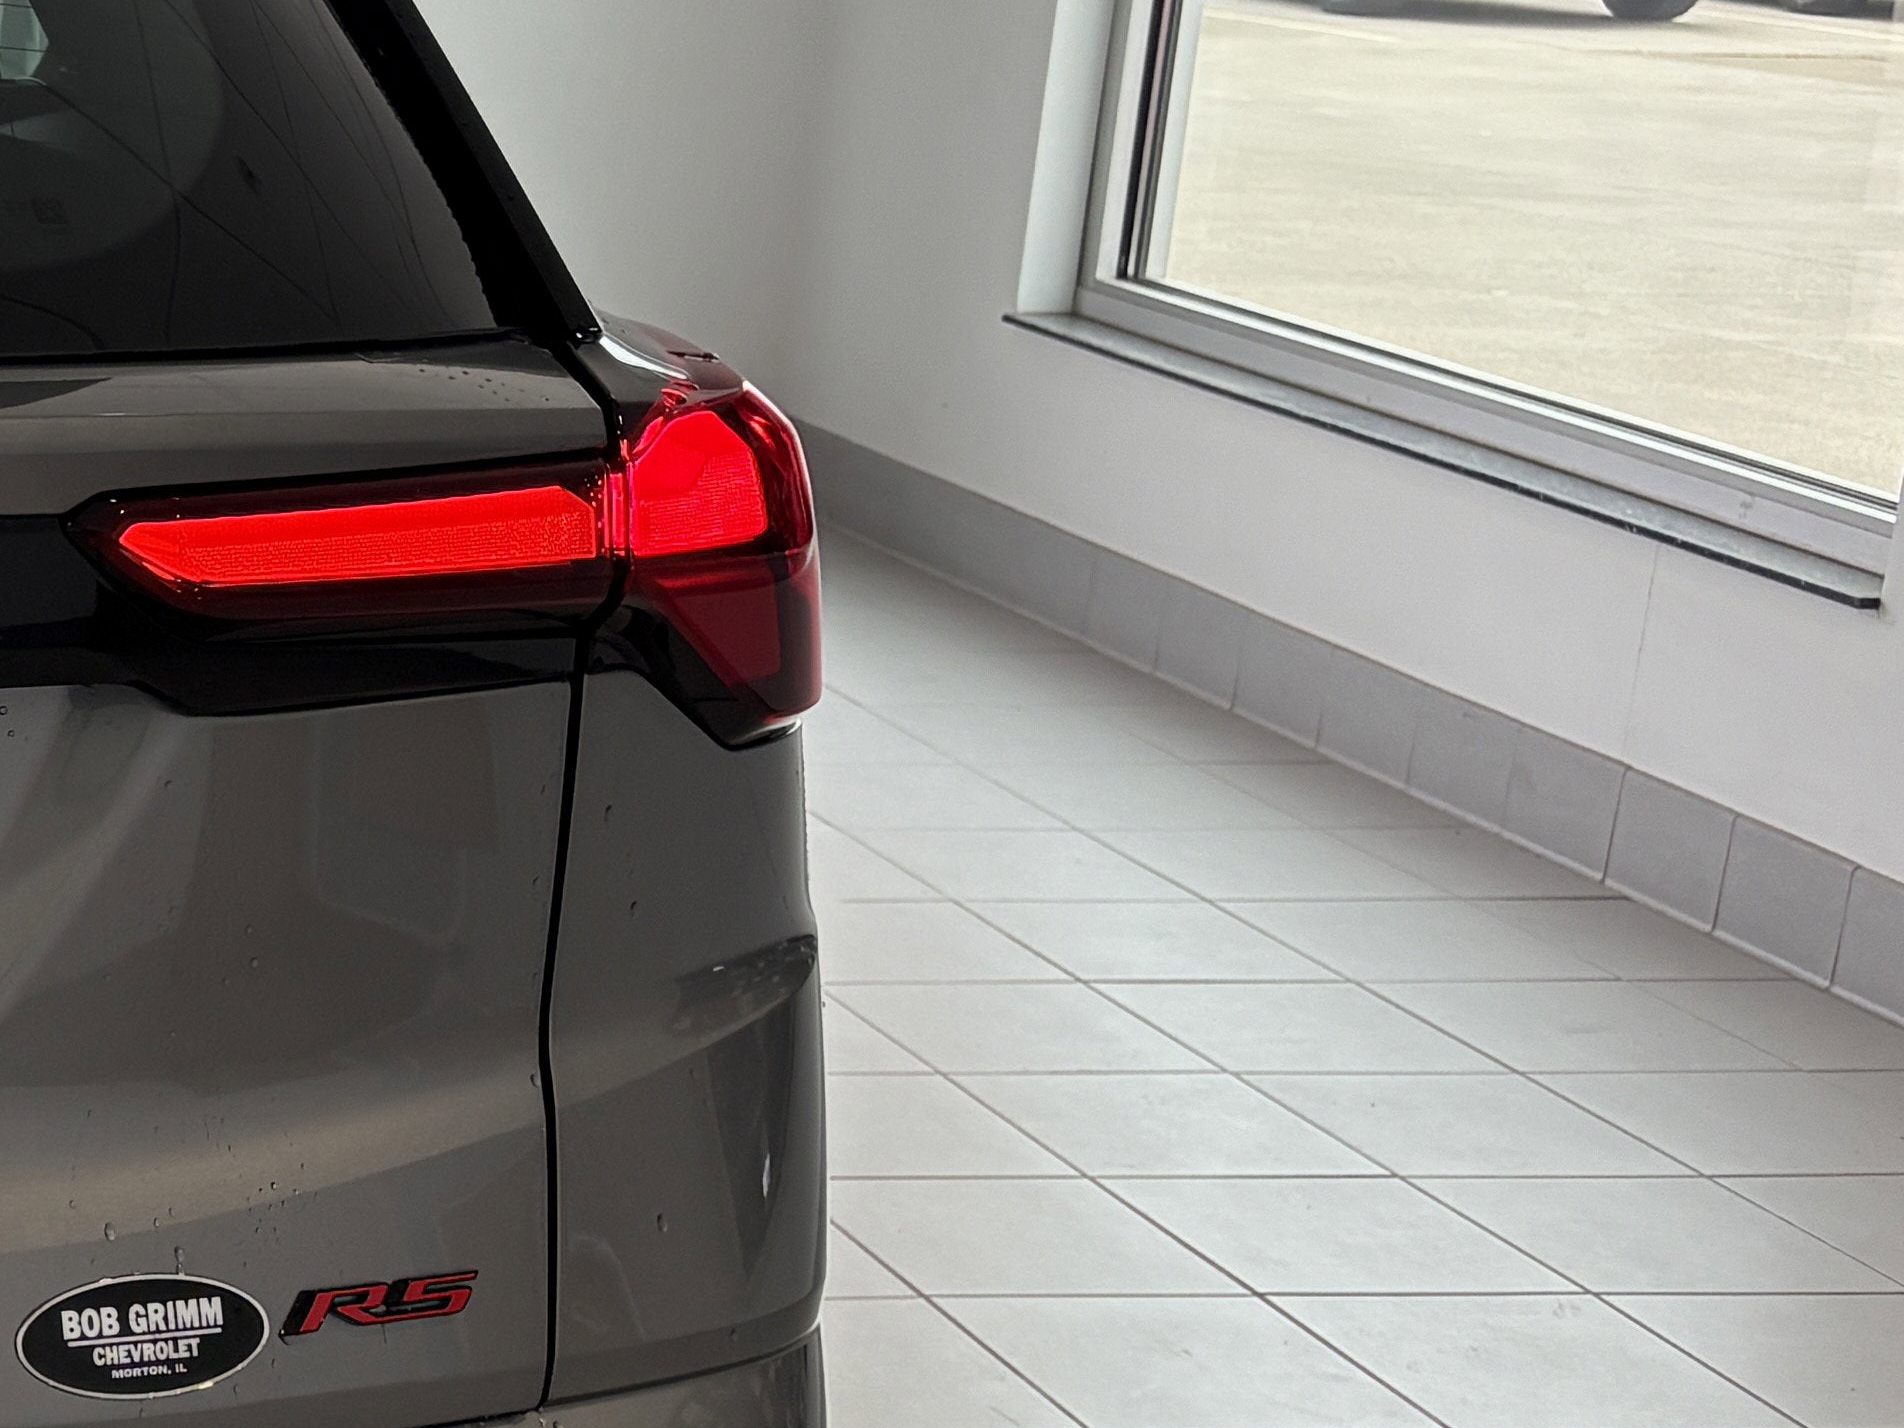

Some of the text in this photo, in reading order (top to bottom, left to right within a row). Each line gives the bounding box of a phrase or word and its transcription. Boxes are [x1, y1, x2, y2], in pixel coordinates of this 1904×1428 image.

[61, 1296, 224, 1340] BOB GRIMM
[279, 1270, 479, 1337] RS
[93, 1337, 201, 1366] CHEVROLET
[175, 1363, 188, 1373] IL
